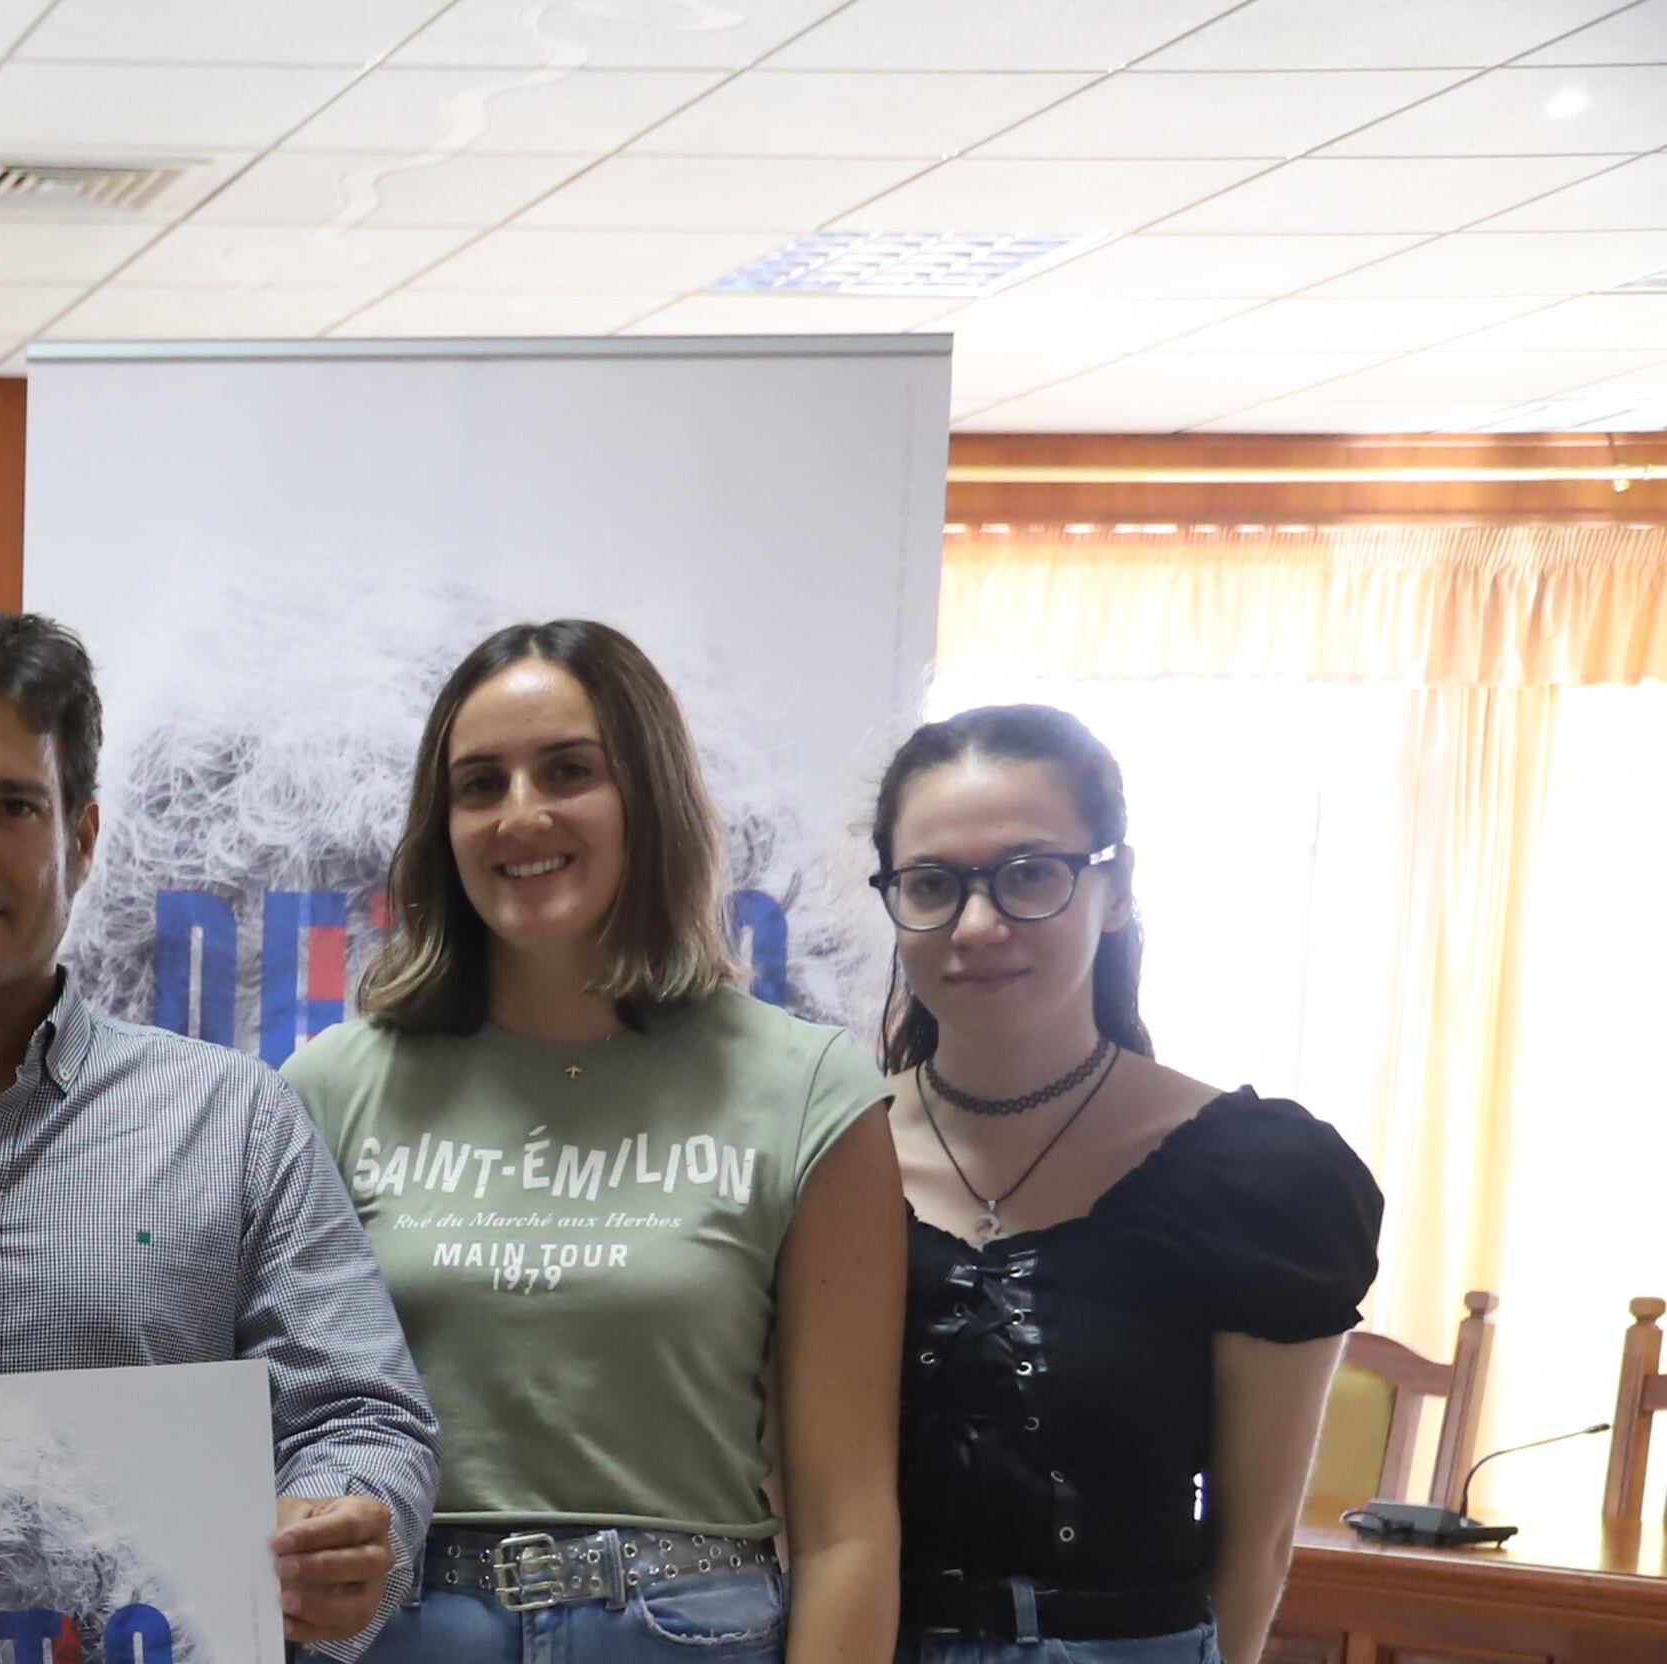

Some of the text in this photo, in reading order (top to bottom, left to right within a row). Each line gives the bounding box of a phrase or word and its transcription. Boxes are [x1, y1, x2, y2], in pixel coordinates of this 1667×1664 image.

[353, 1125, 755, 1204] SAINT-ÉMILION
[394, 1212, 682, 1230] Rue du Marché aux Herbes
[433, 1243, 628, 1268] MAIN TOUR
[493, 1265, 562, 1295] 1979
